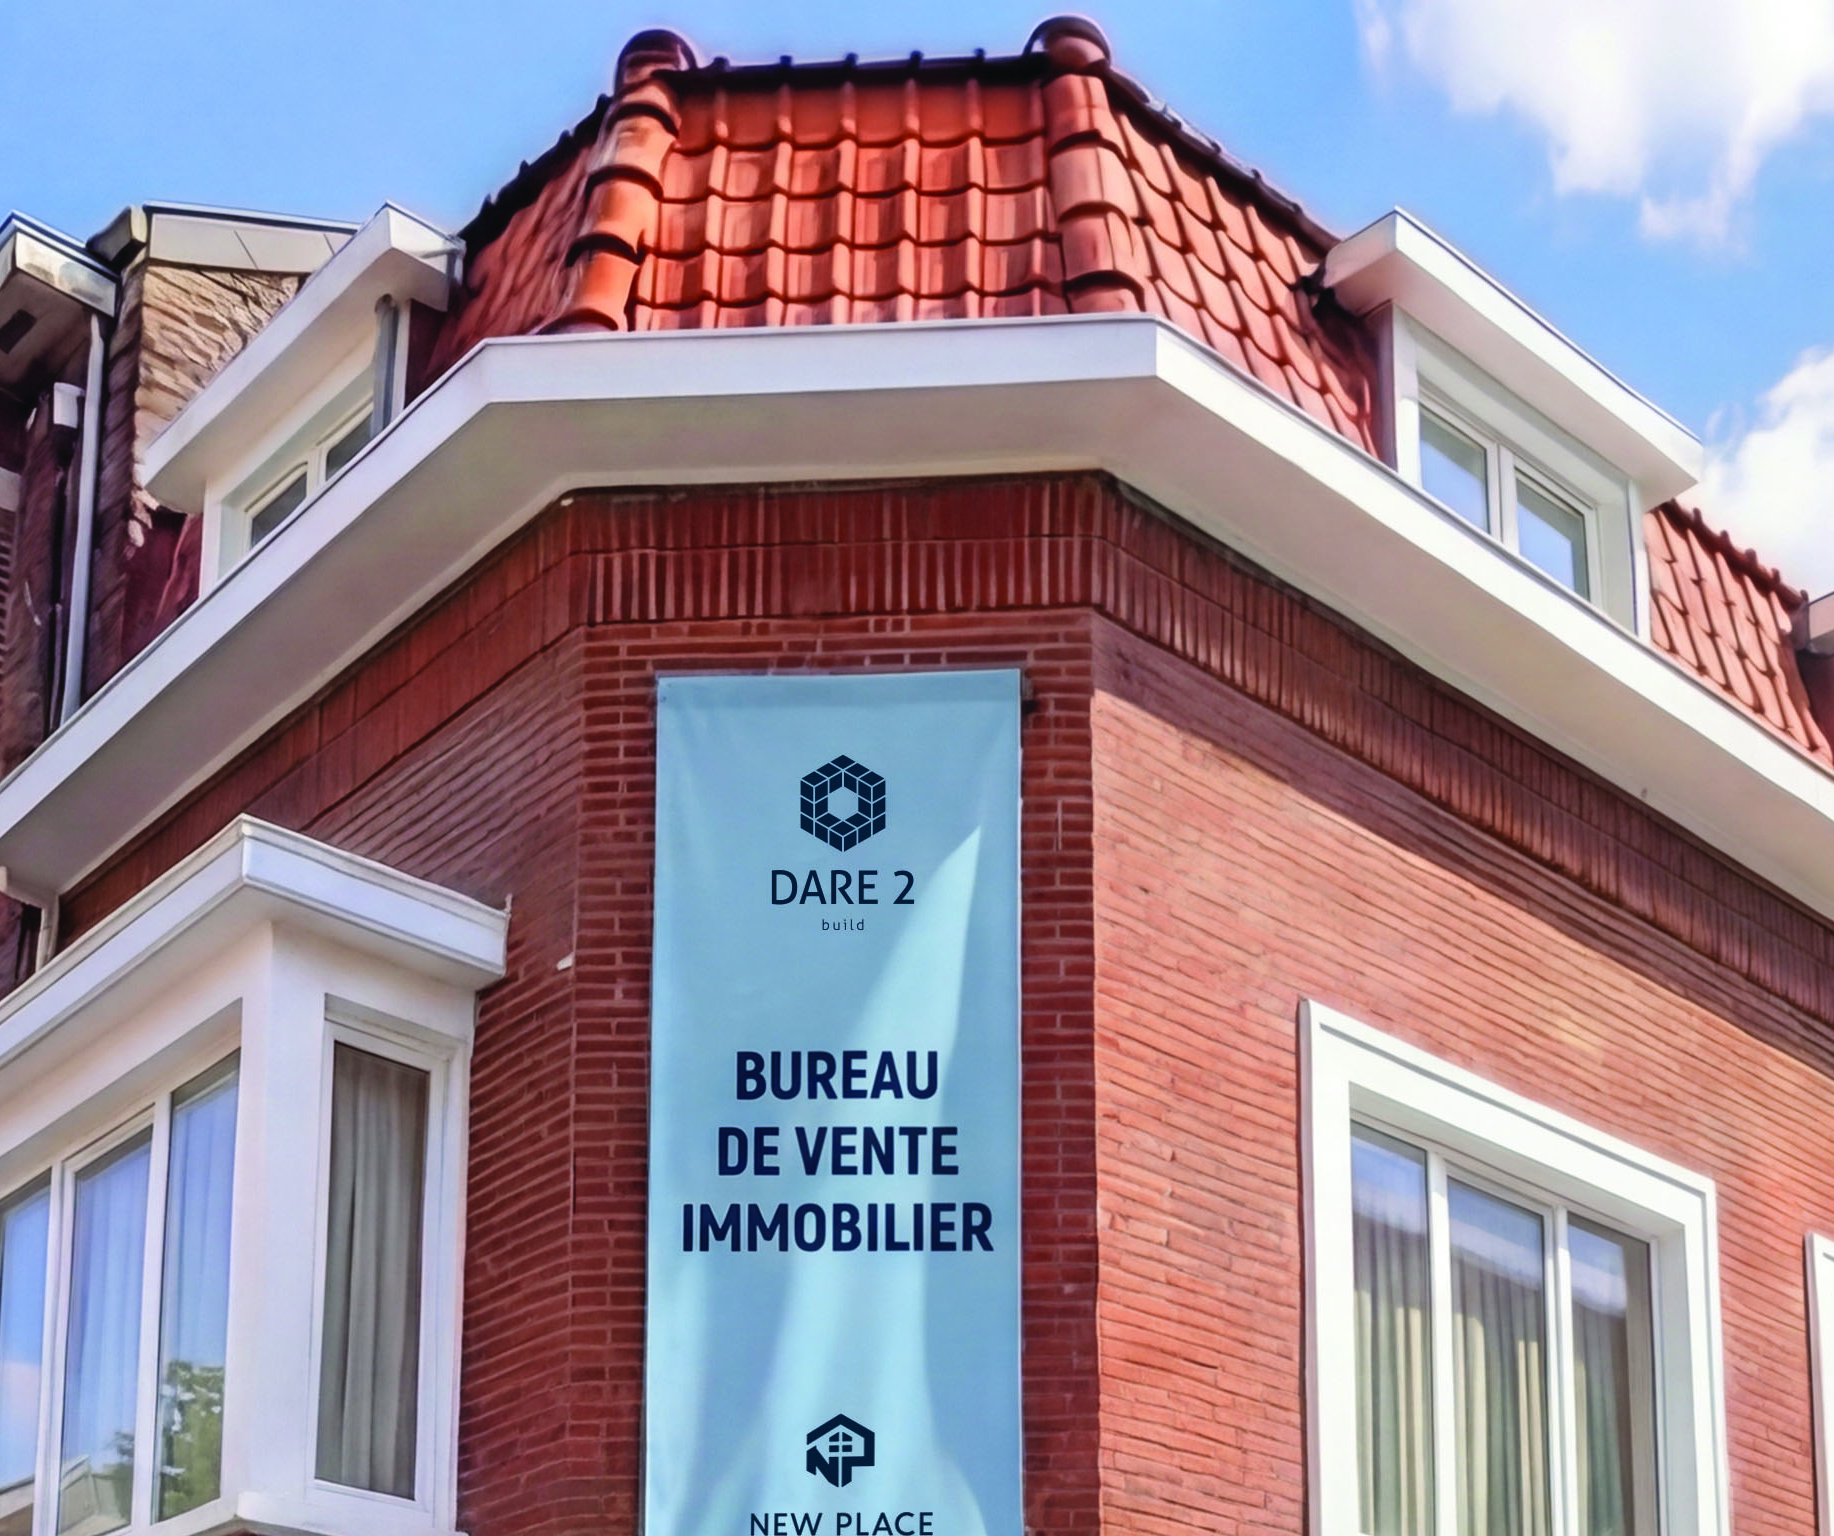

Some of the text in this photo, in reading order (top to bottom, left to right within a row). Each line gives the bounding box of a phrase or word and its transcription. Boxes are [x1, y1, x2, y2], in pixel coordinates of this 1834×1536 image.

[771, 870, 915, 905] DARE 2
[821, 918, 866, 931] build
[736, 1051, 939, 1100] BUREAU
[718, 1126, 959, 1176] DE VENTE
[682, 1203, 995, 1253] IMMOBILIER
[750, 1512, 934, 1536] NEW PLACE
